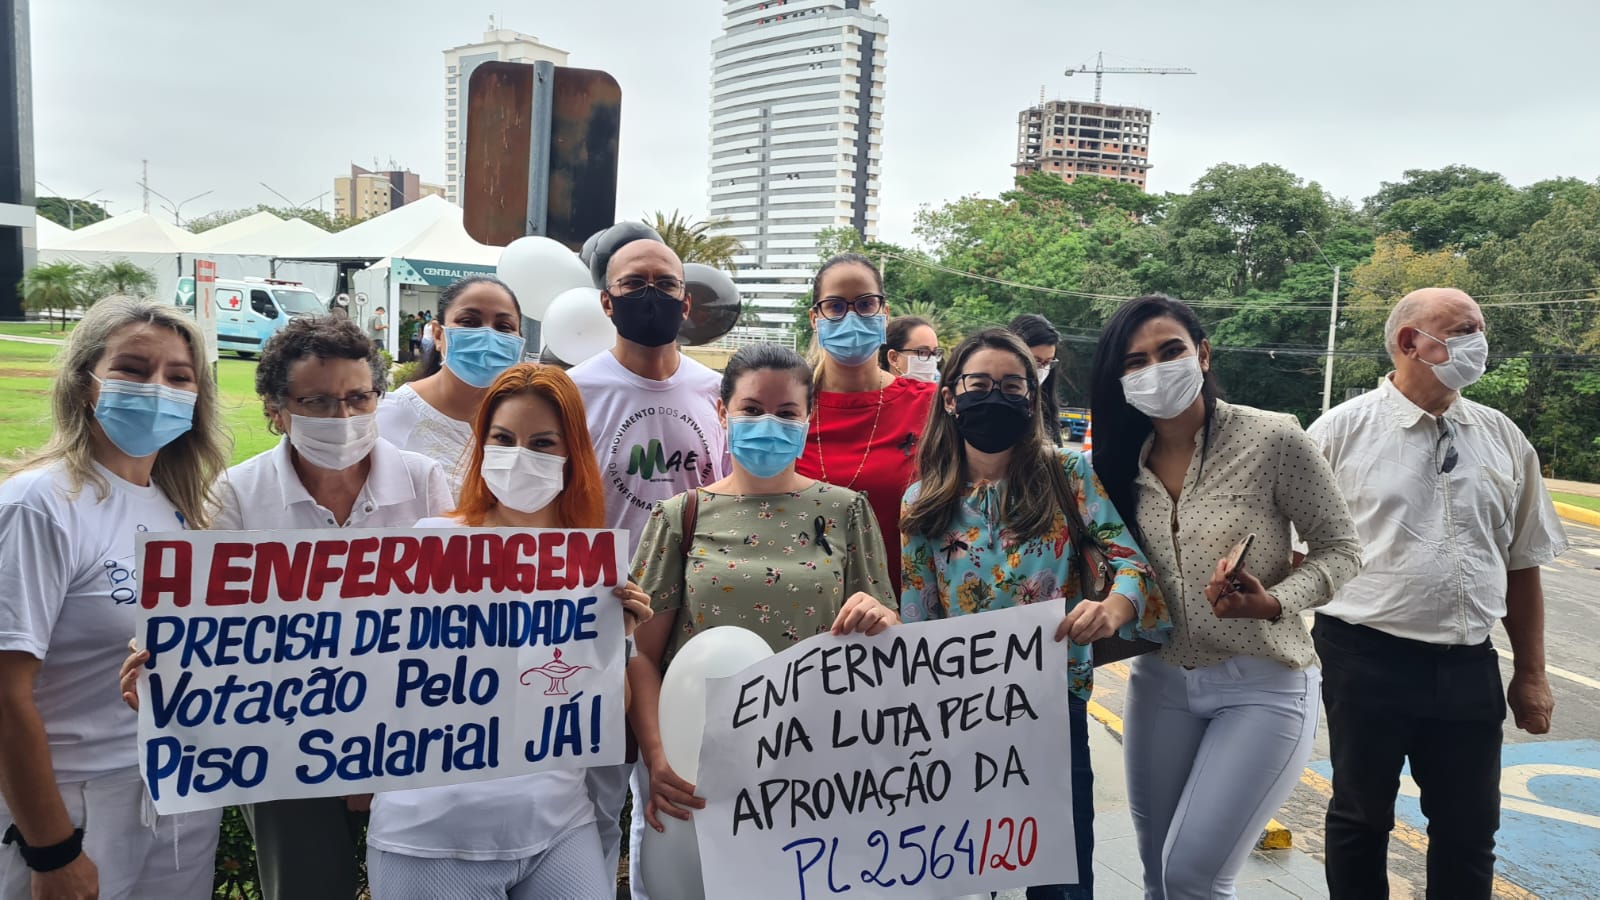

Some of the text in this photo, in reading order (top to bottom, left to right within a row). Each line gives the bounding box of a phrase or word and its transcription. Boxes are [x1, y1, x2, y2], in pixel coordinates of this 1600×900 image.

[423, 267, 462, 278] CENTRAL
[611, 407, 655, 454] MOVIMENTO
[658, 406, 679, 418] DOS
[608, 463, 652, 511] DA ENFERMA
[142, 532, 617, 609] A ENFERMAGEM
[145, 597, 598, 669] PRECISA DE DIGNIDADE
[149, 656, 499, 728] Votação Pelo
[733, 626, 1043, 728] ENFERMAGEM
[146, 691, 602, 801] Piso Salarial JÁ!
[757, 683, 1039, 768] NA LUTA PELA
[733, 745, 1030, 836] APROVAÇÃO DA
[783, 816, 1038, 900] PL 2564/20
